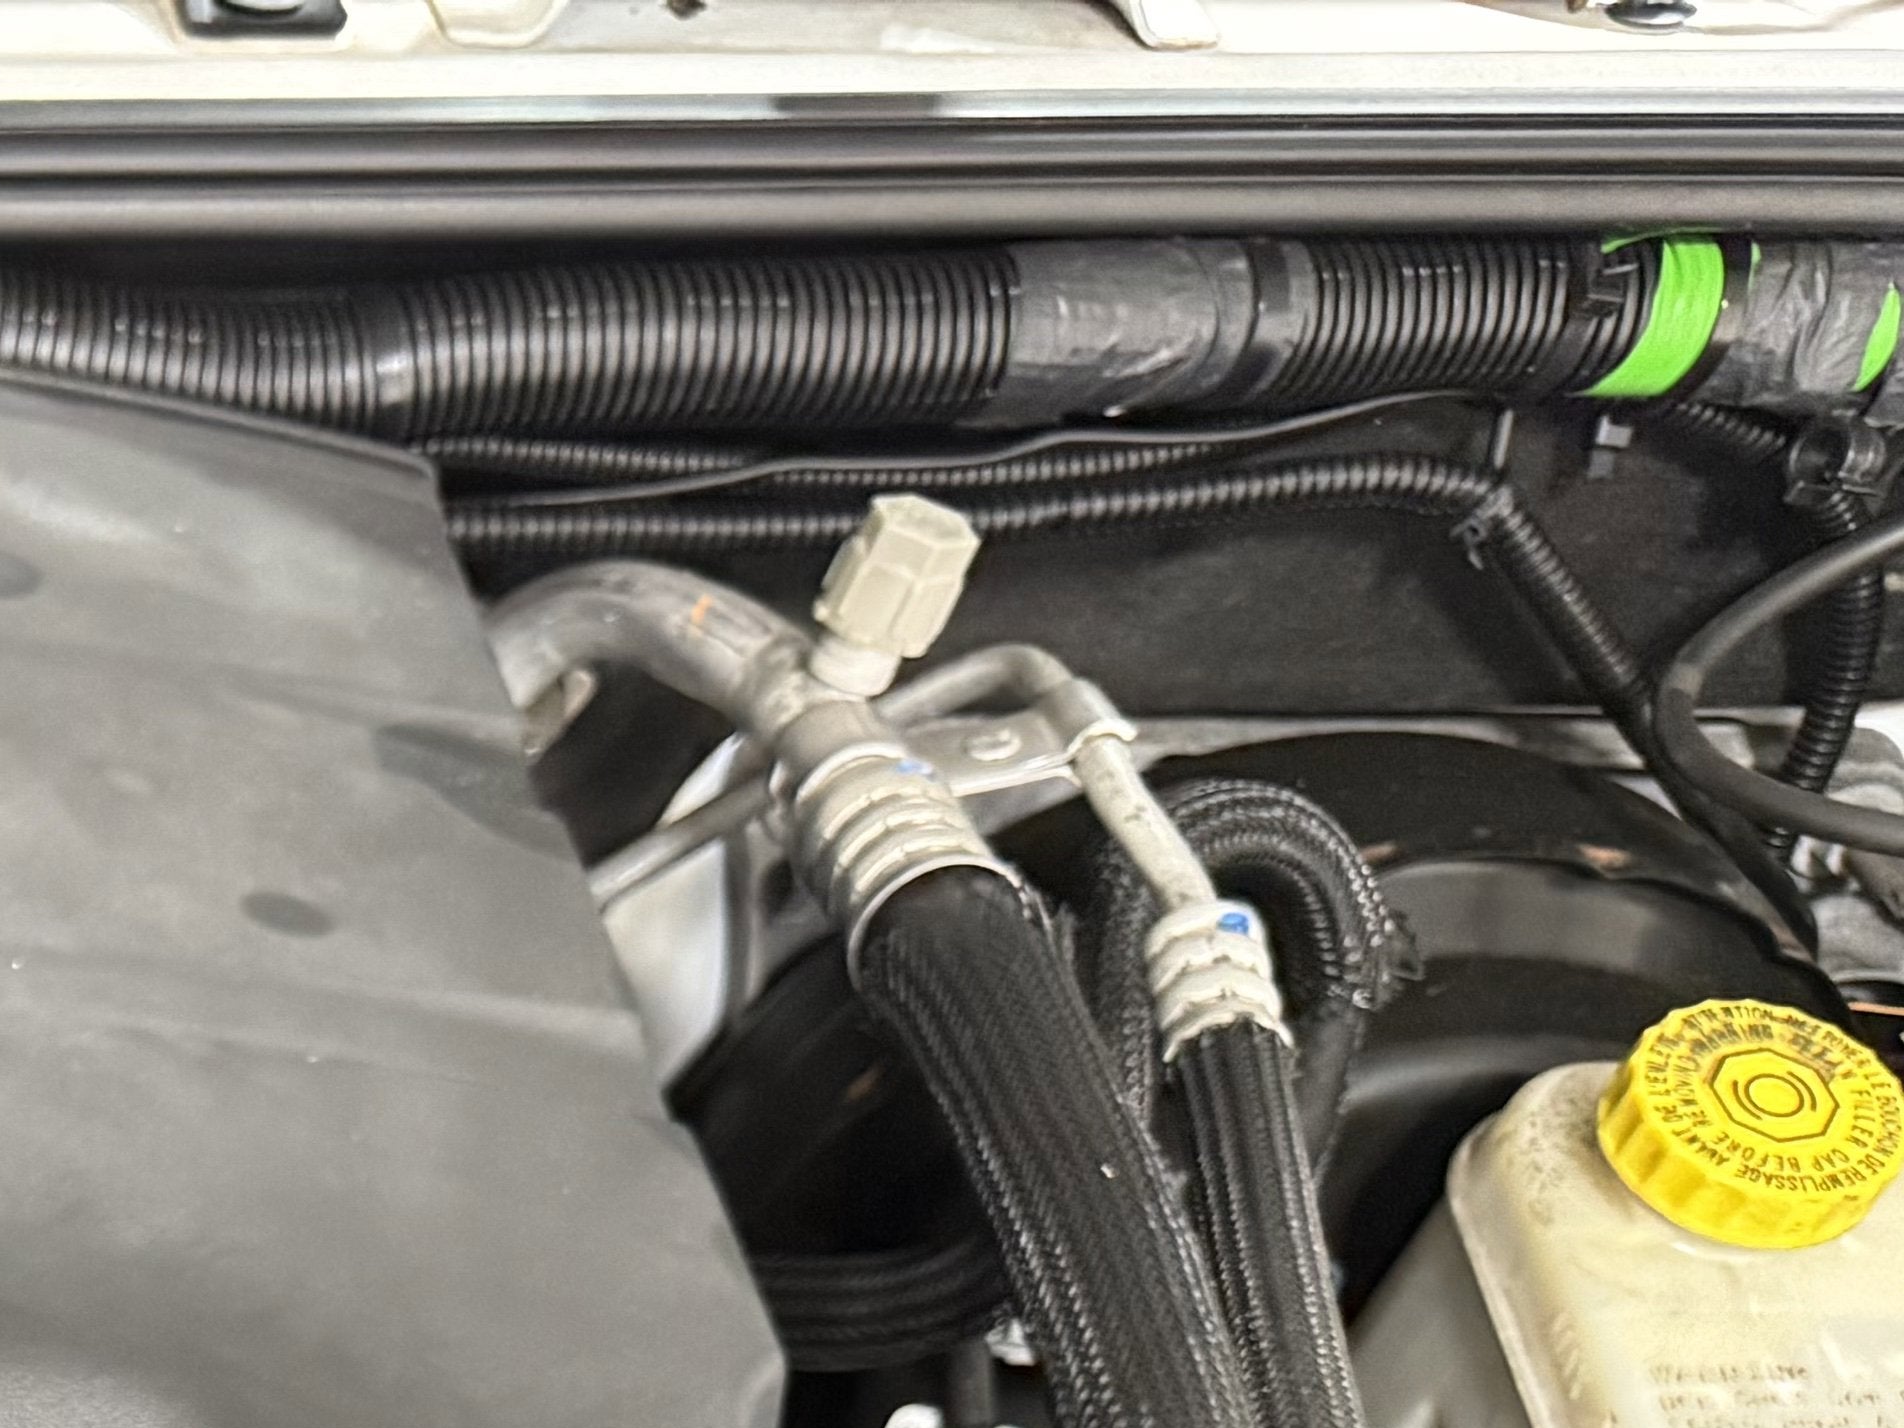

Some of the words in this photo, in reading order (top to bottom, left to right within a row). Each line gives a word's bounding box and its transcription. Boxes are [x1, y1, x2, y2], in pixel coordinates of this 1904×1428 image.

[1845, 1087, 1876, 1149] FILLER
[1712, 1131, 1801, 1174] BEFORE
[1812, 1149, 1850, 1173] CAP
[1856, 1153, 1886, 1177] DE
[1734, 1165, 1868, 1193] REMPLISSAGE
